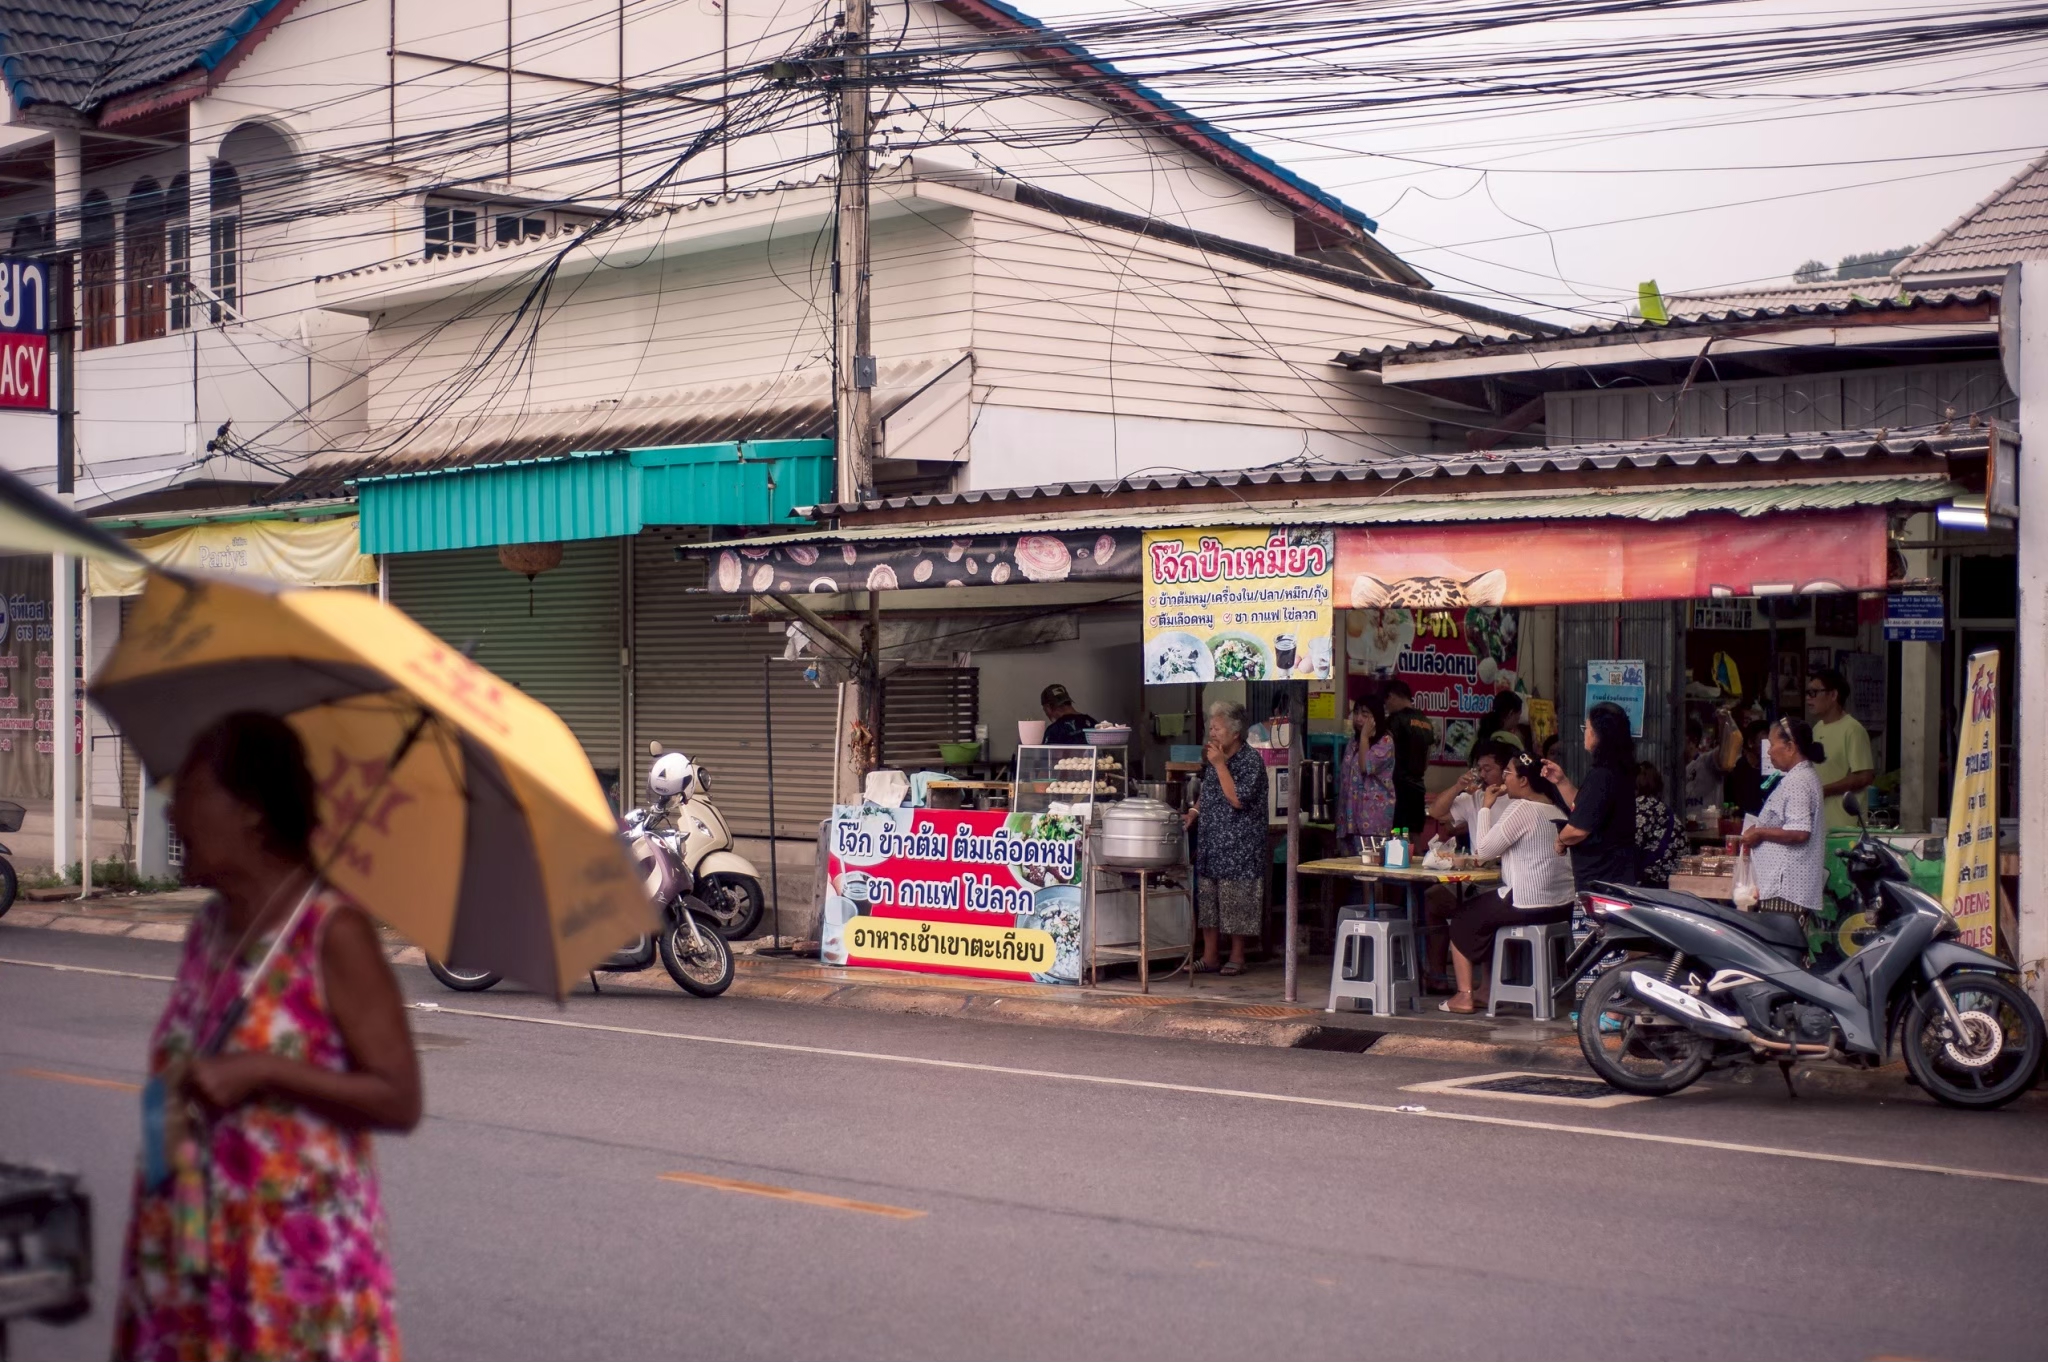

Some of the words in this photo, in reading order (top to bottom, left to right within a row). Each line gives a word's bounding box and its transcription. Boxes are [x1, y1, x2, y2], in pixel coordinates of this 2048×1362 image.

[1, 344, 44, 398] ACY
[199, 544, 248, 575] Pariya
[1149, 527, 1328, 583] โจ๊กป้าเหมี่ยว
[10, 594, 44, 621] จีทีเอส
[1159, 585, 1328, 606] ข้าวต้มหมู/เครื่องใน/ปลา/หมึก/กุ้ง
[16, 625, 33, 641] GTS
[1158, 610, 1214, 629] ต้มเลือดหมู
[1235, 611, 1248, 623] ชา
[1251, 608, 1280, 623] กาแฟ
[1283, 607, 1317, 622] ไข่ลวก
[1397, 644, 1478, 685] ต้มเลือดหมู
[838, 820, 872, 856] โจ๊ก
[879, 822, 947, 860] ข้าวต้ม
[952, 826, 1075, 878] ต้มเลือดหมู
[867, 877, 893, 905] ชา
[899, 875, 959, 909] กาแฟ
[964, 873, 1035, 915] ไข่ลวก
[854, 924, 1044, 963] อาหารเช้าเขาตะเกียบ
